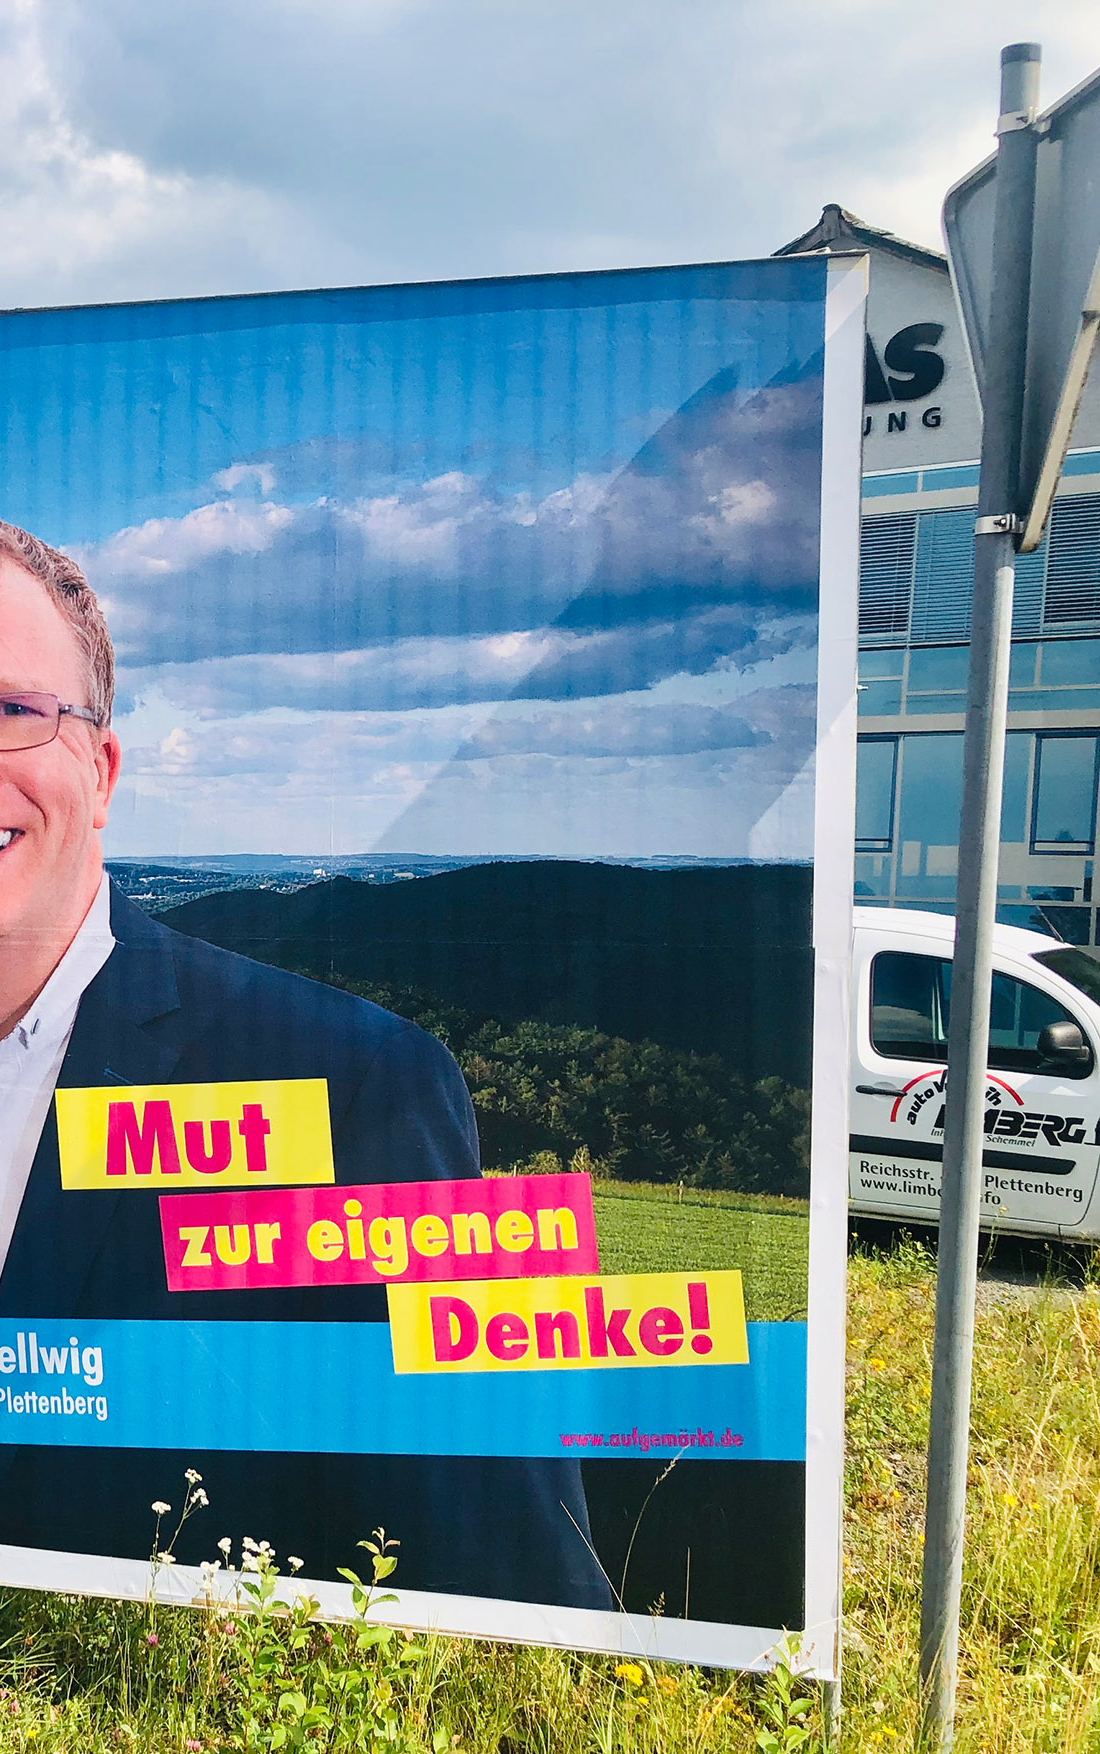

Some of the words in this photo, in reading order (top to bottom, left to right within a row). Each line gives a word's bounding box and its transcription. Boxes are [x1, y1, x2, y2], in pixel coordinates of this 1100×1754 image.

[105, 1100, 271, 1176] Mut
[985, 1134, 1036, 1148] Schemmel
[860, 1160, 935, 1181] Reichsstr.
[984, 1174, 1083, 1203] Plettenberg
[178, 1219, 281, 1267] zur
[307, 1198, 579, 1276] eigenen
[429, 1282, 715, 1362] Denke!
